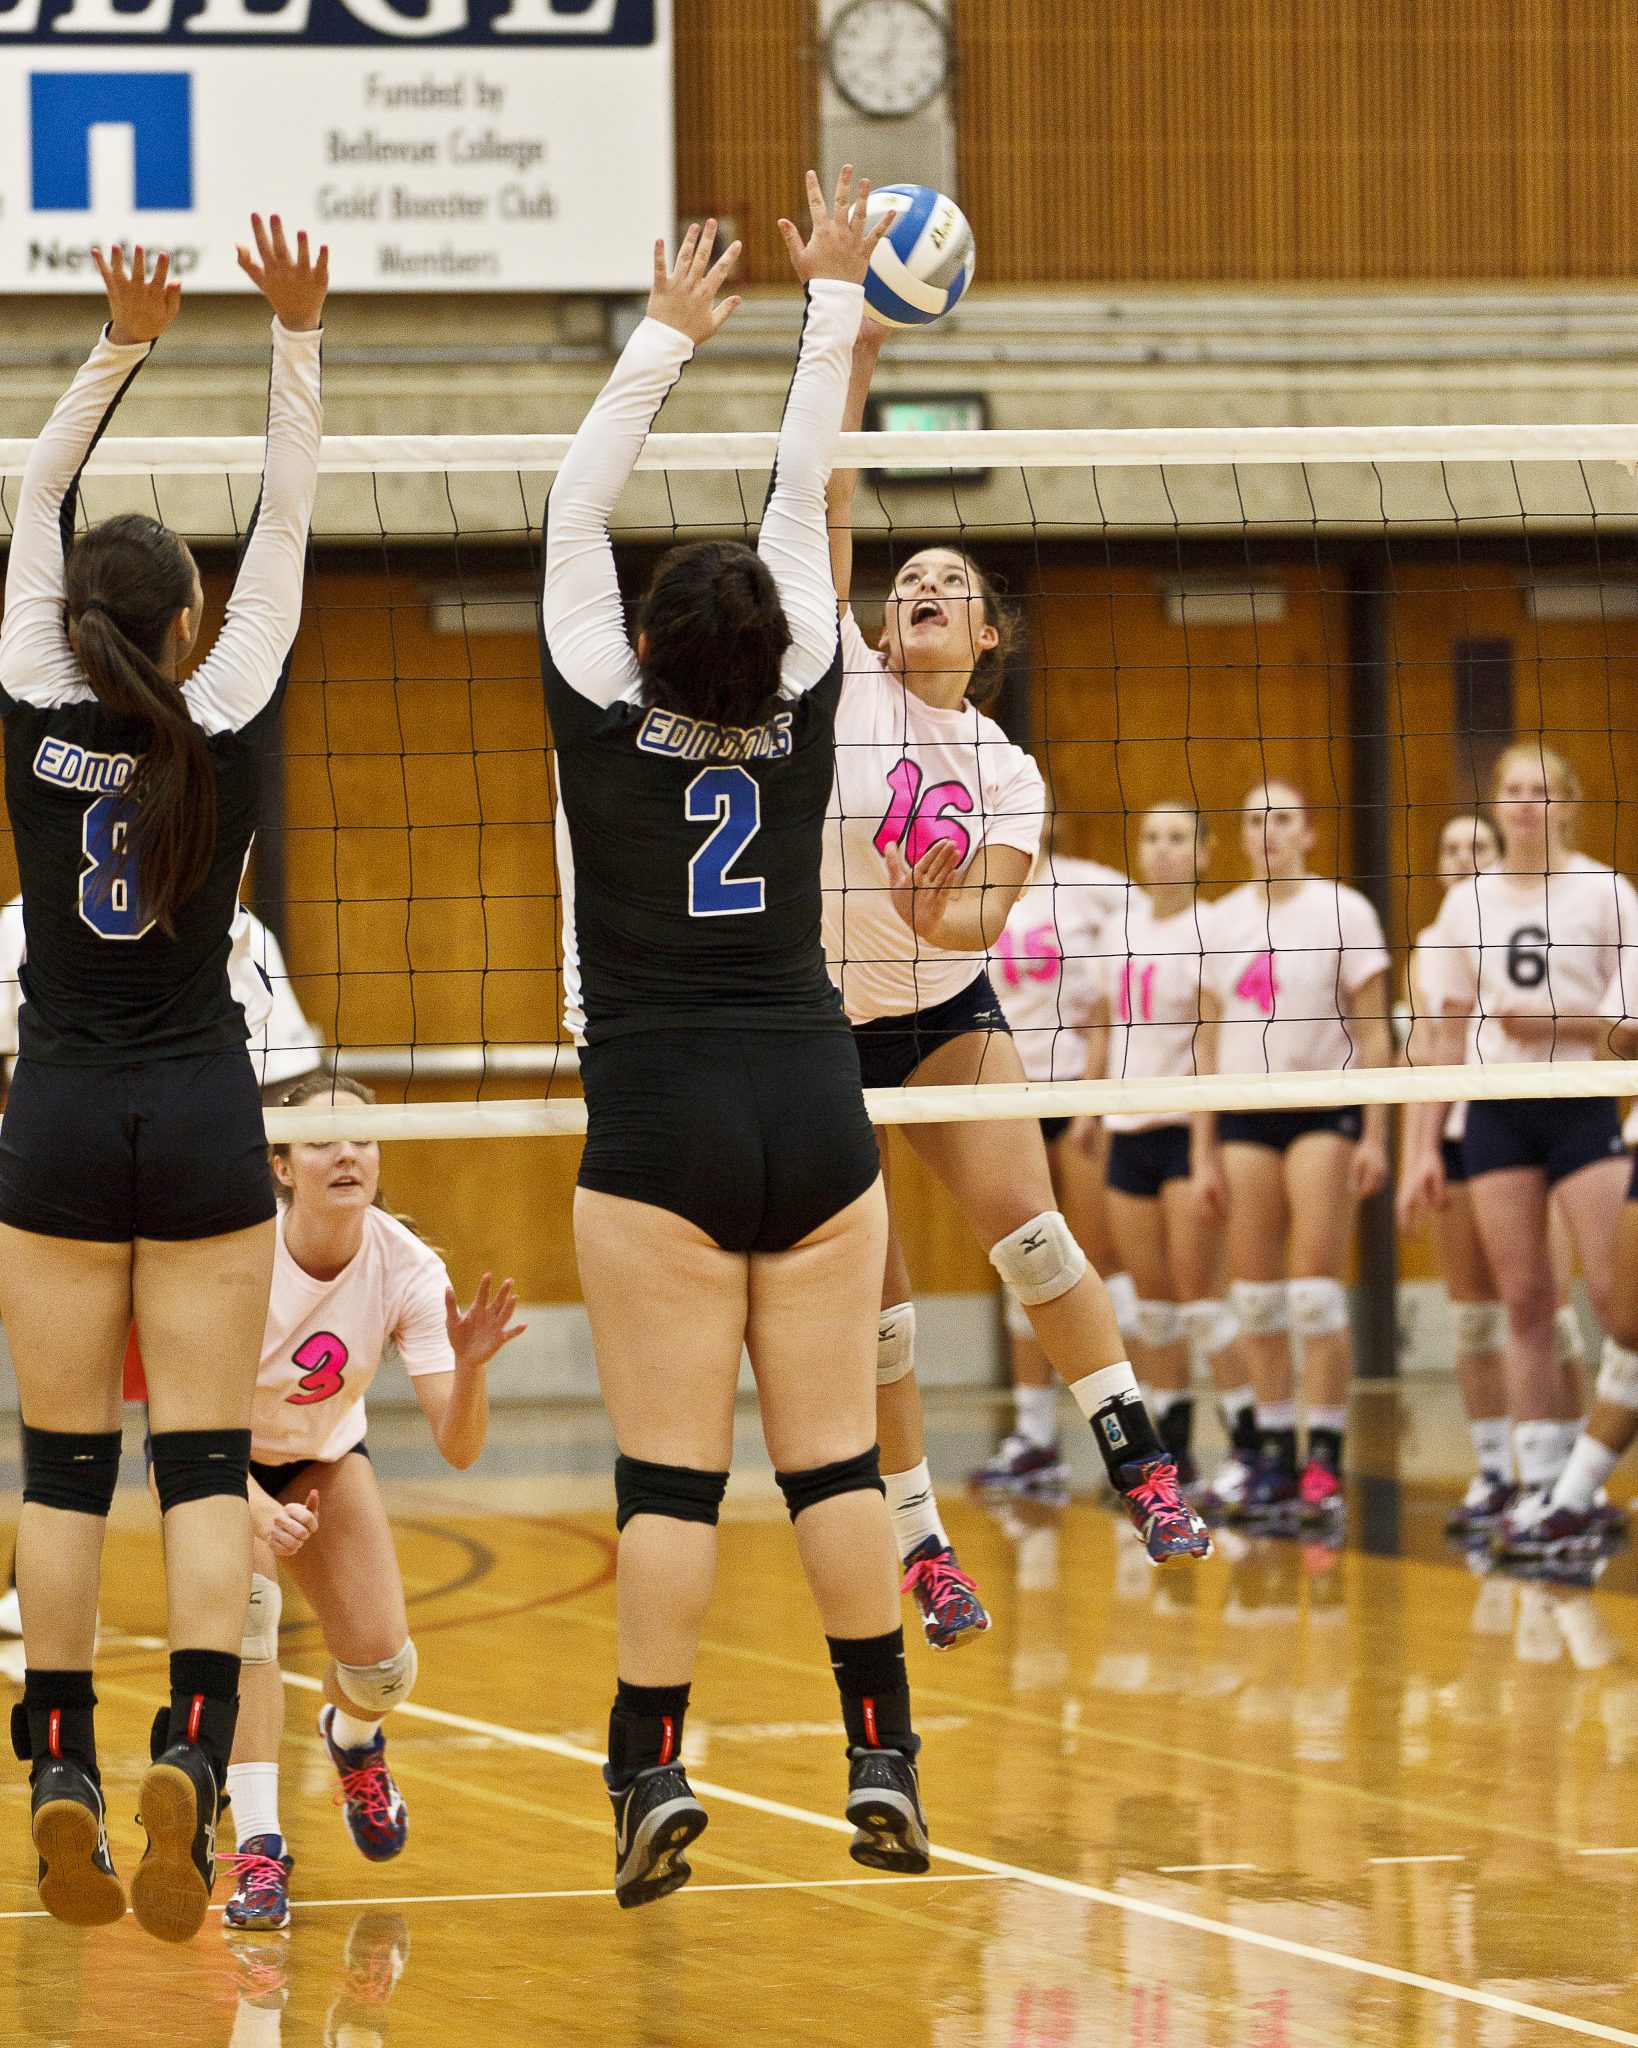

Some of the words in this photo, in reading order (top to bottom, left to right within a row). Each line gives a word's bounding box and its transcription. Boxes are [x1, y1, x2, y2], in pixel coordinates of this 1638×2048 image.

[324, 129, 437, 164] Bellevue
[449, 128, 546, 172] College
[685, 765, 766, 917] 2
[872, 757, 974, 870] 16
[78, 793, 158, 940] 8
[995, 922, 1060, 988] 15
[1233, 950, 1281, 1013] 4
[1506, 922, 1548, 989] 6
[1116, 960, 1155, 1023] 11
[285, 1330, 349, 1406] 3
